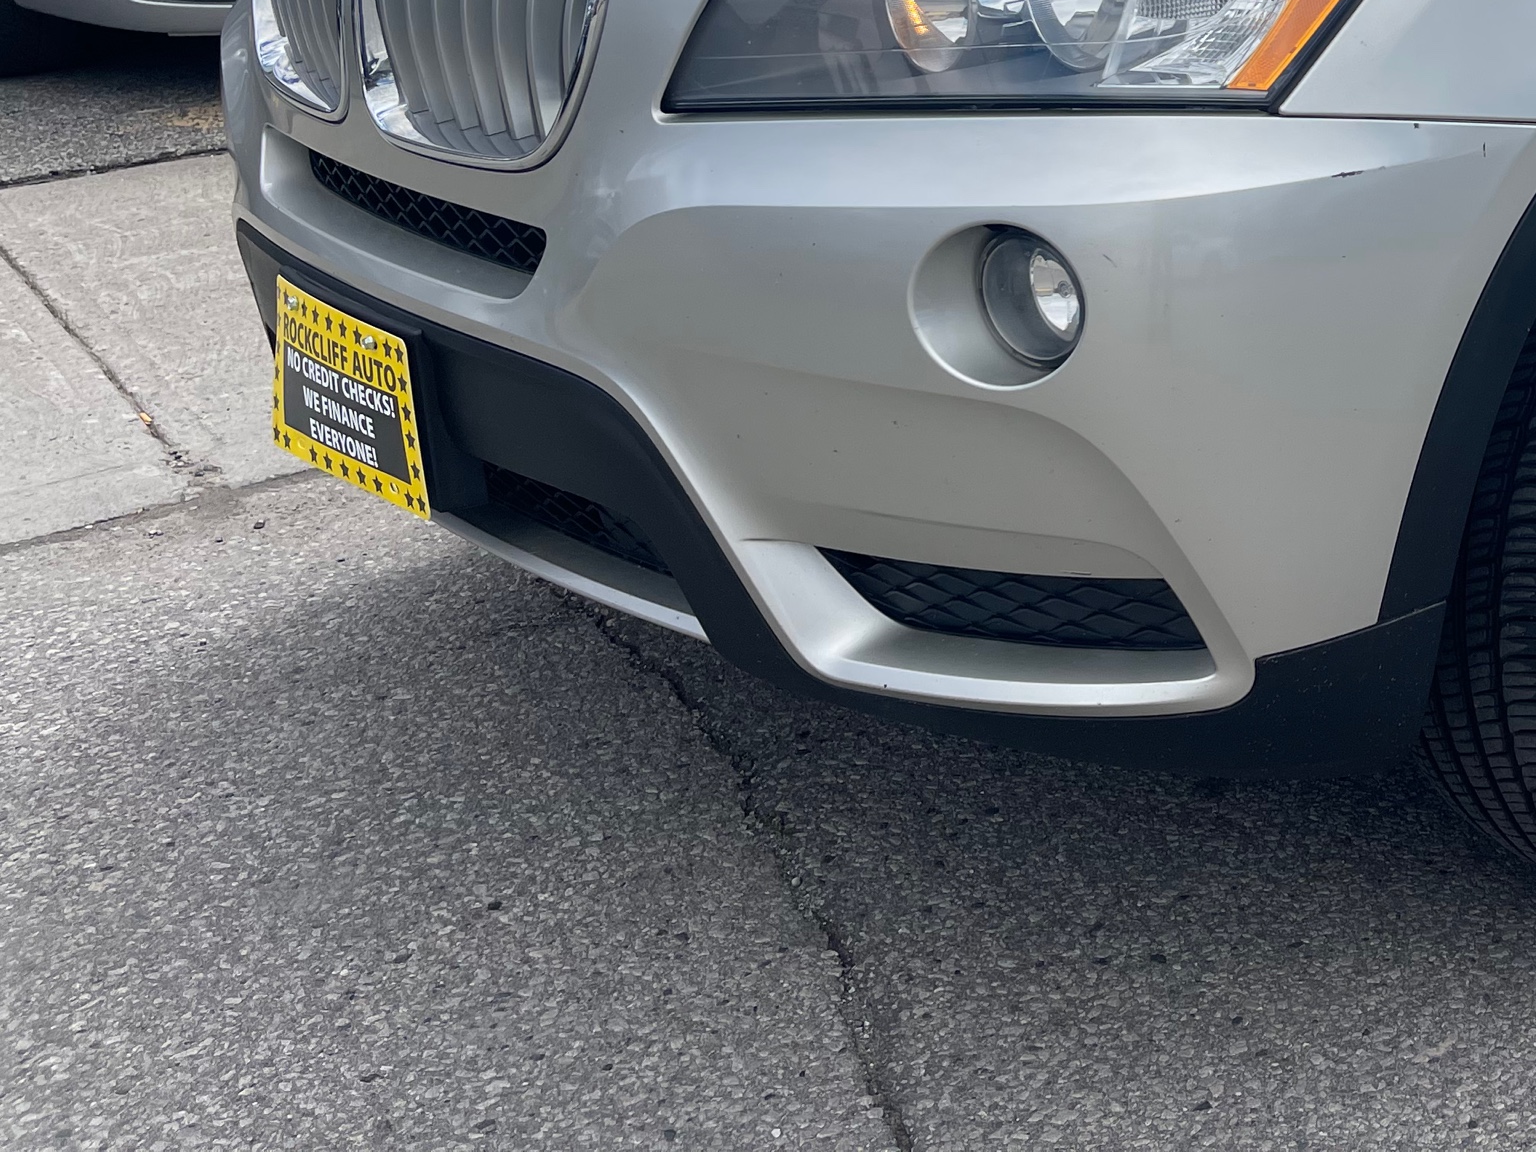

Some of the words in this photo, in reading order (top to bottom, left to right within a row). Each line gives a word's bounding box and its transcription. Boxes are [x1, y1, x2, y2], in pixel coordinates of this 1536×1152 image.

[283, 313, 348, 371] ROCKCLIFF
[353, 353, 397, 392] AUTO
[287, 346, 301, 373] NO
[302, 357, 340, 393] CREDIT
[342, 378, 396, 418] CHECKS!
[303, 385, 321, 413] WE
[321, 393, 375, 439] FINANCE
[309, 418, 379, 468] EVERYONE!
